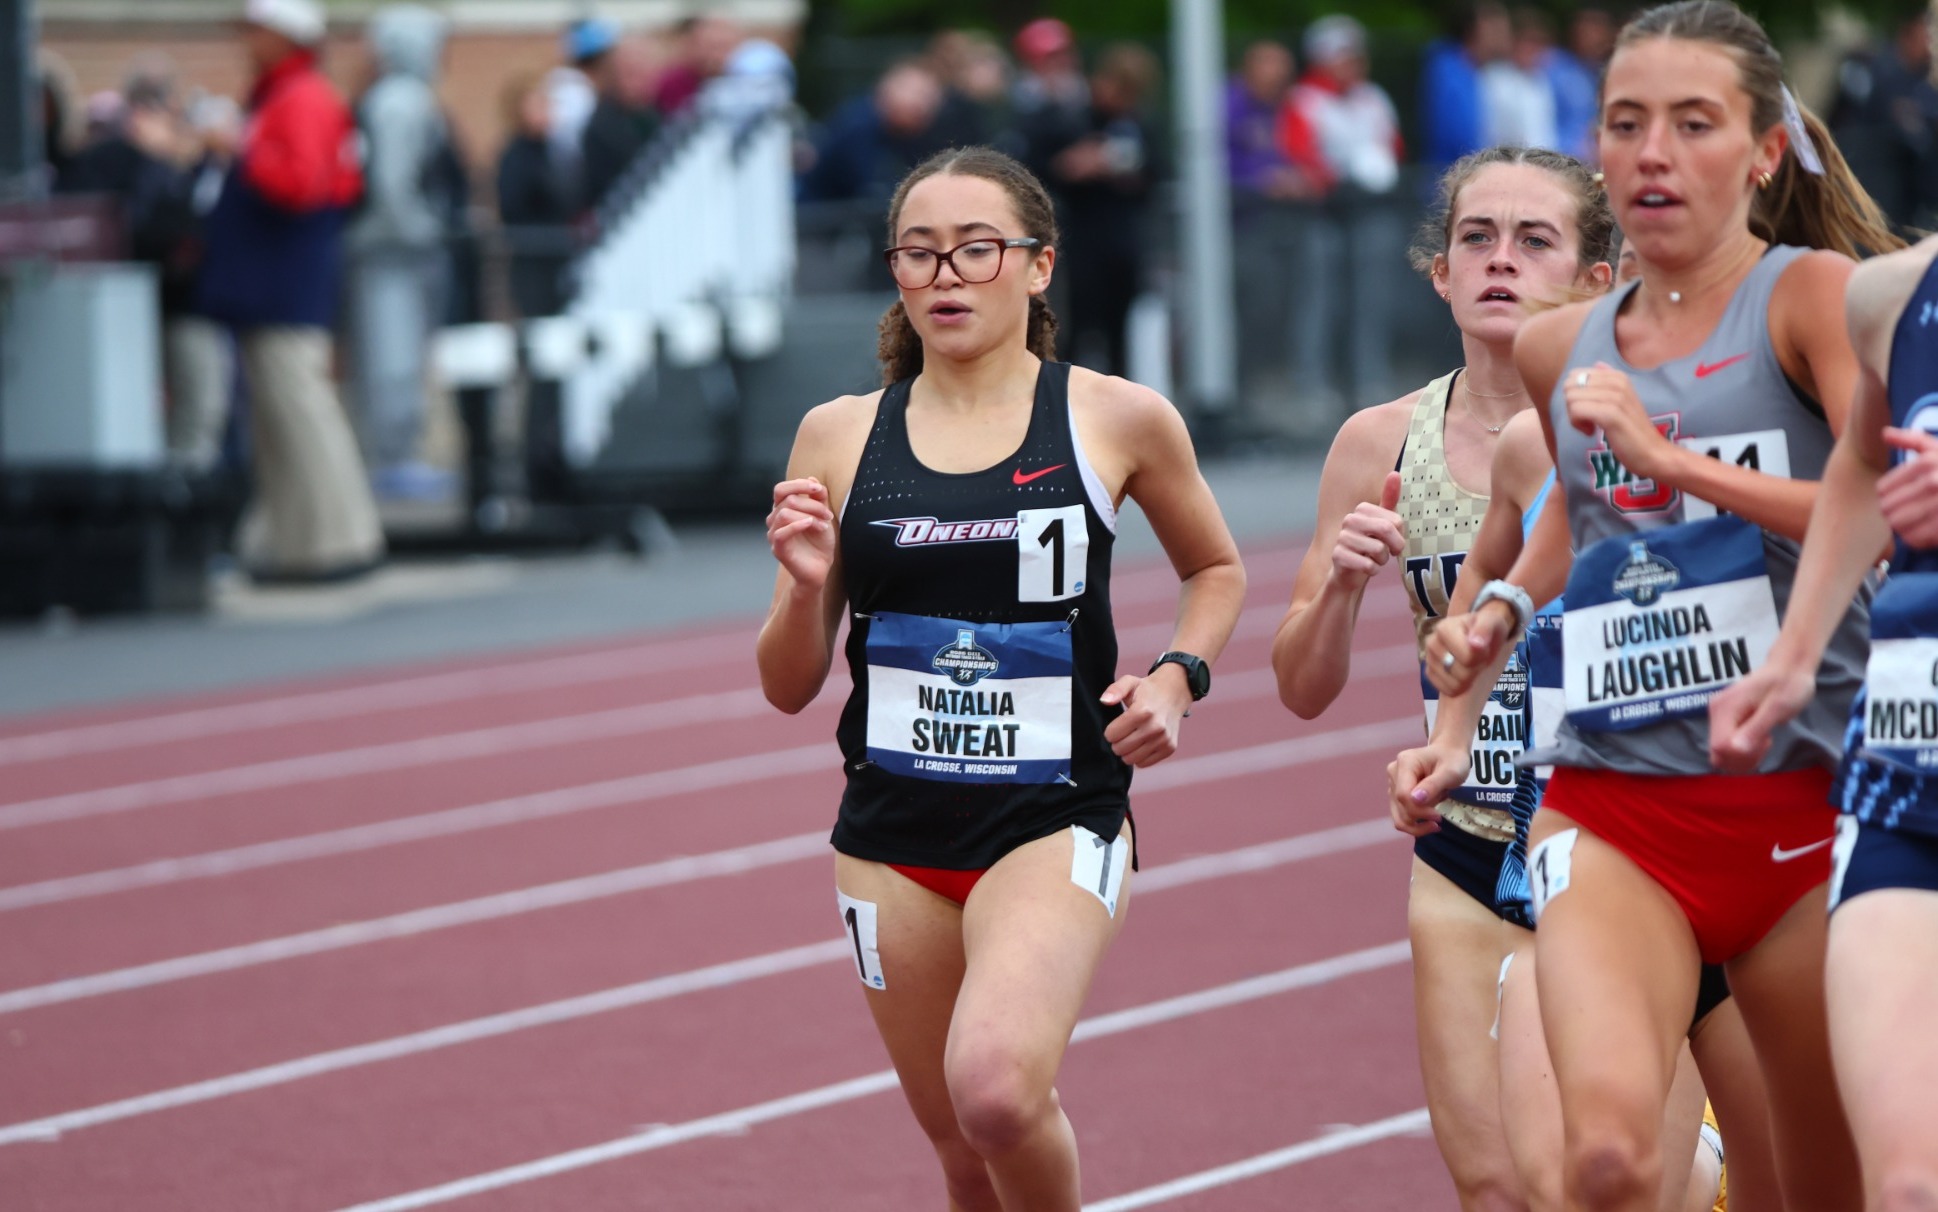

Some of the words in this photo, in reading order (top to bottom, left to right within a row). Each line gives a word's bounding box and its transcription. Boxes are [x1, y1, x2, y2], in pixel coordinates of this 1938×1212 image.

[897, 518, 1019, 546] ONEON
[1037, 518, 1065, 597] 1
[1603, 602, 1713, 649] LUCINDA
[935, 657, 997, 670] CHAMPIONSHIPS
[1586, 636, 1752, 702] LAUGHLIN
[918, 684, 1015, 716] NATALIA
[1610, 706, 1622, 723] LA
[1623, 699, 1664, 720] CROSSE,
[912, 717, 1020, 757] SWEAT
[1871, 702, 1938, 739] MCD
[914, 758, 924, 769] LA
[925, 760, 962, 773] CROSSE,
[964, 763, 1017, 775] WISCONSIN
[1476, 791, 1486, 801] LA
[1486, 792, 1515, 803] CROSS
[1536, 845, 1549, 902] 1
[845, 906, 867, 980] 1
